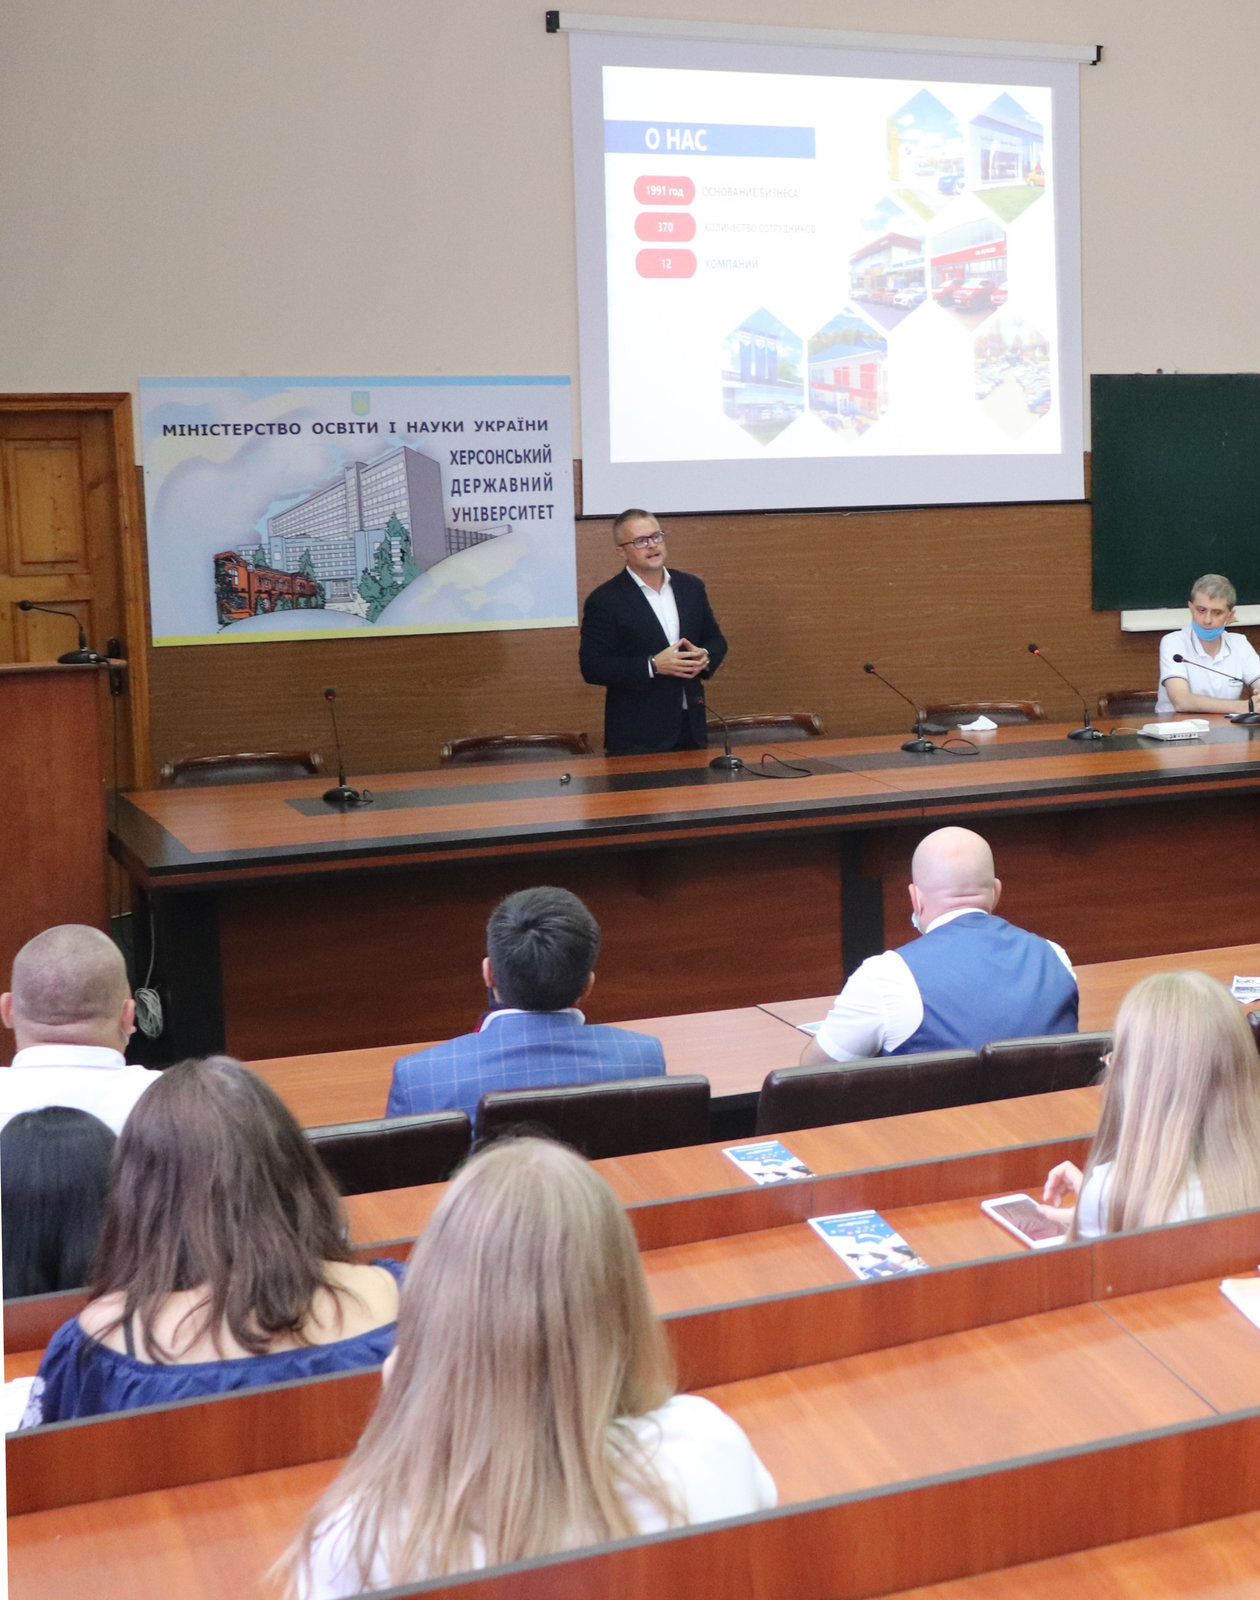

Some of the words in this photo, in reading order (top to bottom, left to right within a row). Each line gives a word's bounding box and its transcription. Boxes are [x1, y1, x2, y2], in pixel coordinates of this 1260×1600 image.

[645, 127, 660, 150] О
[666, 128, 708, 151] НАС
[646, 185, 667, 196] 1991
[668, 187, 685, 198] год
[702, 186, 757, 198] ОСНОВАНИЕ
[760, 187, 799, 199] БИЗНЕСА
[657, 222, 674, 233] 370
[661, 258, 672, 270] 12
[163, 423, 301, 436] МІНІСТЕРСТВО
[312, 422, 379, 435] ОСВІТИ
[407, 420, 464, 433] НАУКИ
[474, 418, 549, 432] УКРАЇНИ
[449, 444, 552, 466] ХЕРСОНСЬКИЙ
[450, 472, 554, 498] ДЕРЖАВНИЙ
[452, 504, 555, 523] УНІВЕРСИТЕТ
